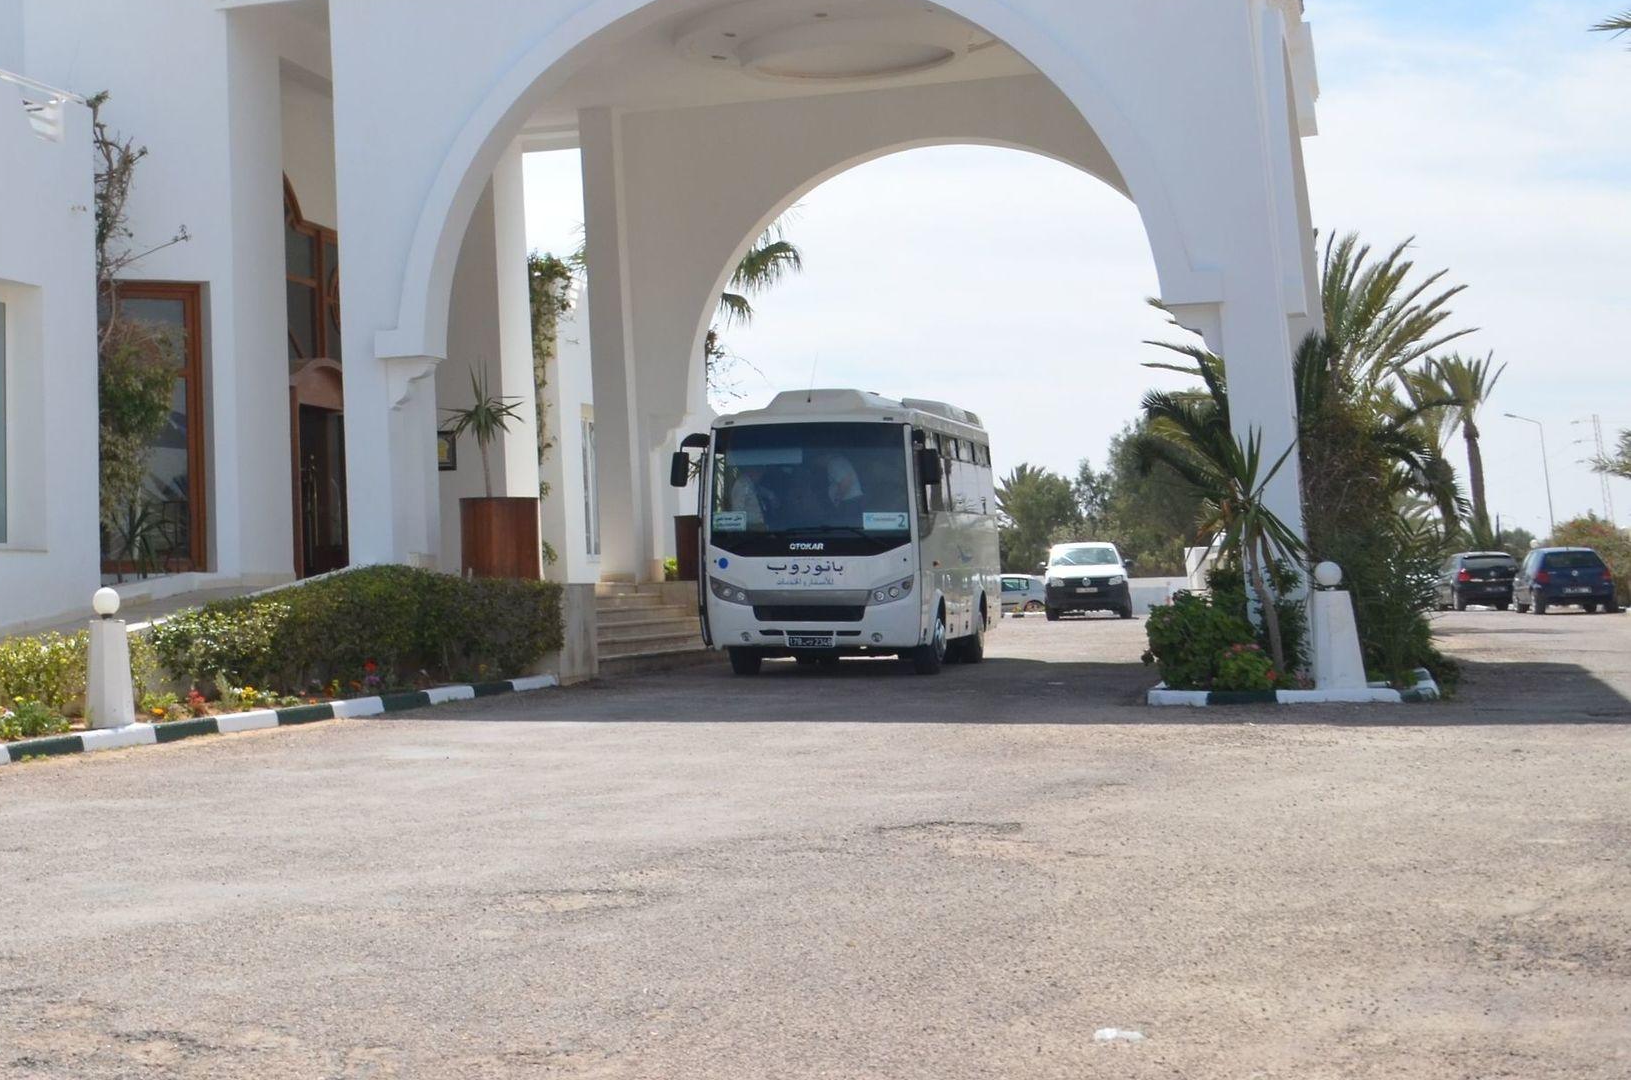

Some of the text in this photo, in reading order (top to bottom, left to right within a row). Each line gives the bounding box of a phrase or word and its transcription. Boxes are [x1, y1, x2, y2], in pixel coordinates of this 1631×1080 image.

[898, 514, 906, 528] 2
[789, 542, 824, 550] OTOKAR
[767, 561, 843, 576] بانوروب
